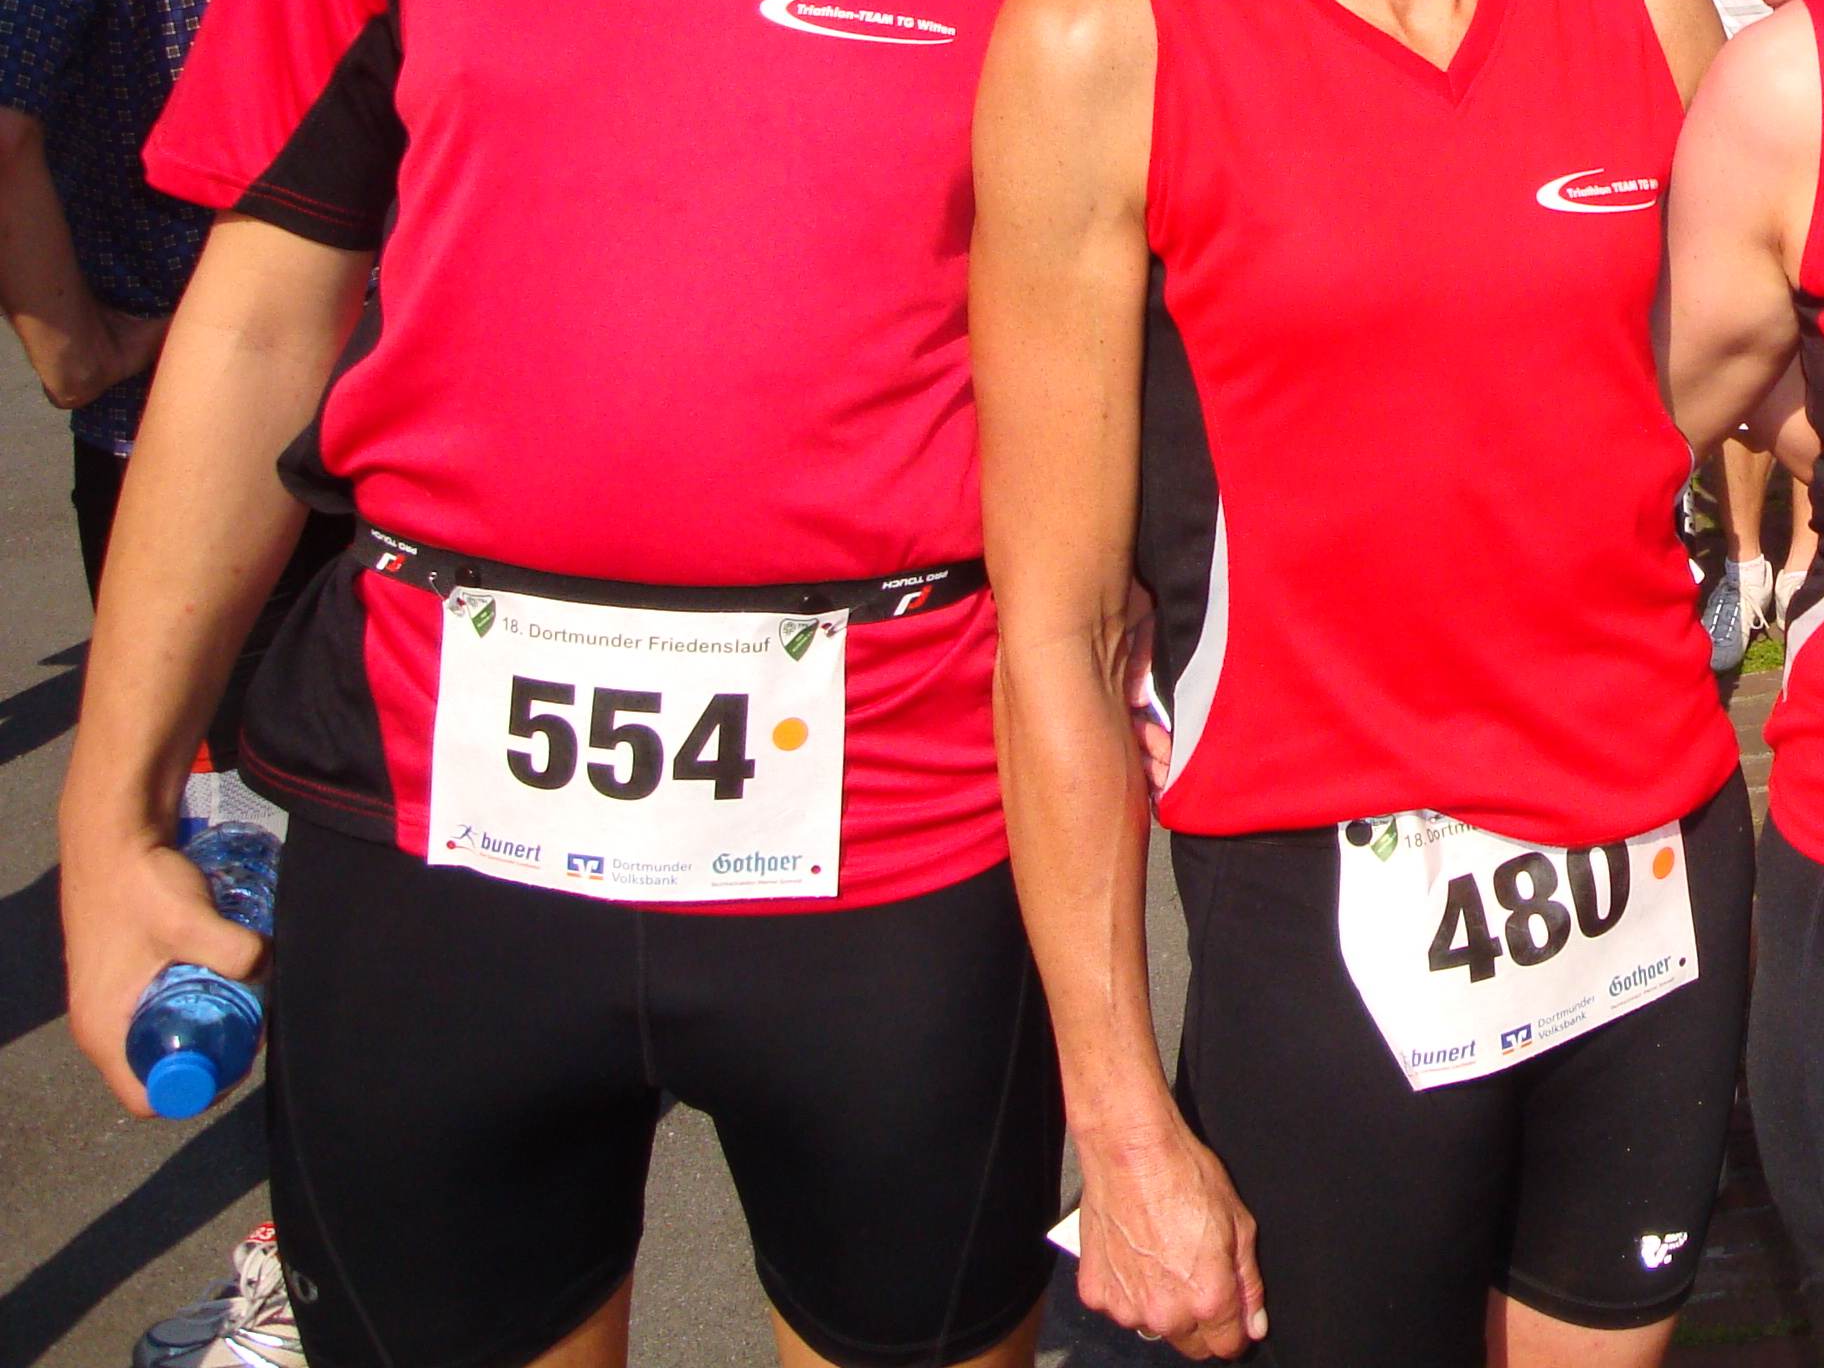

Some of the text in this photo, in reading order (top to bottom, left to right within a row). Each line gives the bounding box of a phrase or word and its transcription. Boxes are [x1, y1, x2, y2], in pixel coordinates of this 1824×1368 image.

[882, 576, 924, 590] TOUCH
[502, 617, 524, 637] 18.
[529, 624, 643, 650] Dortmunder
[649, 636, 771, 653] Friedenslauf
[506, 675, 755, 800] 554
[481, 832, 541, 862] bunert
[612, 858, 693, 873] Dortmunder
[712, 852, 803, 876] Gothaer
[611, 872, 679, 887] Volksbank
[1428, 842, 1630, 983] 480
[1608, 955, 1672, 998] Gothaer
[1411, 1040, 1476, 1068] bunert
